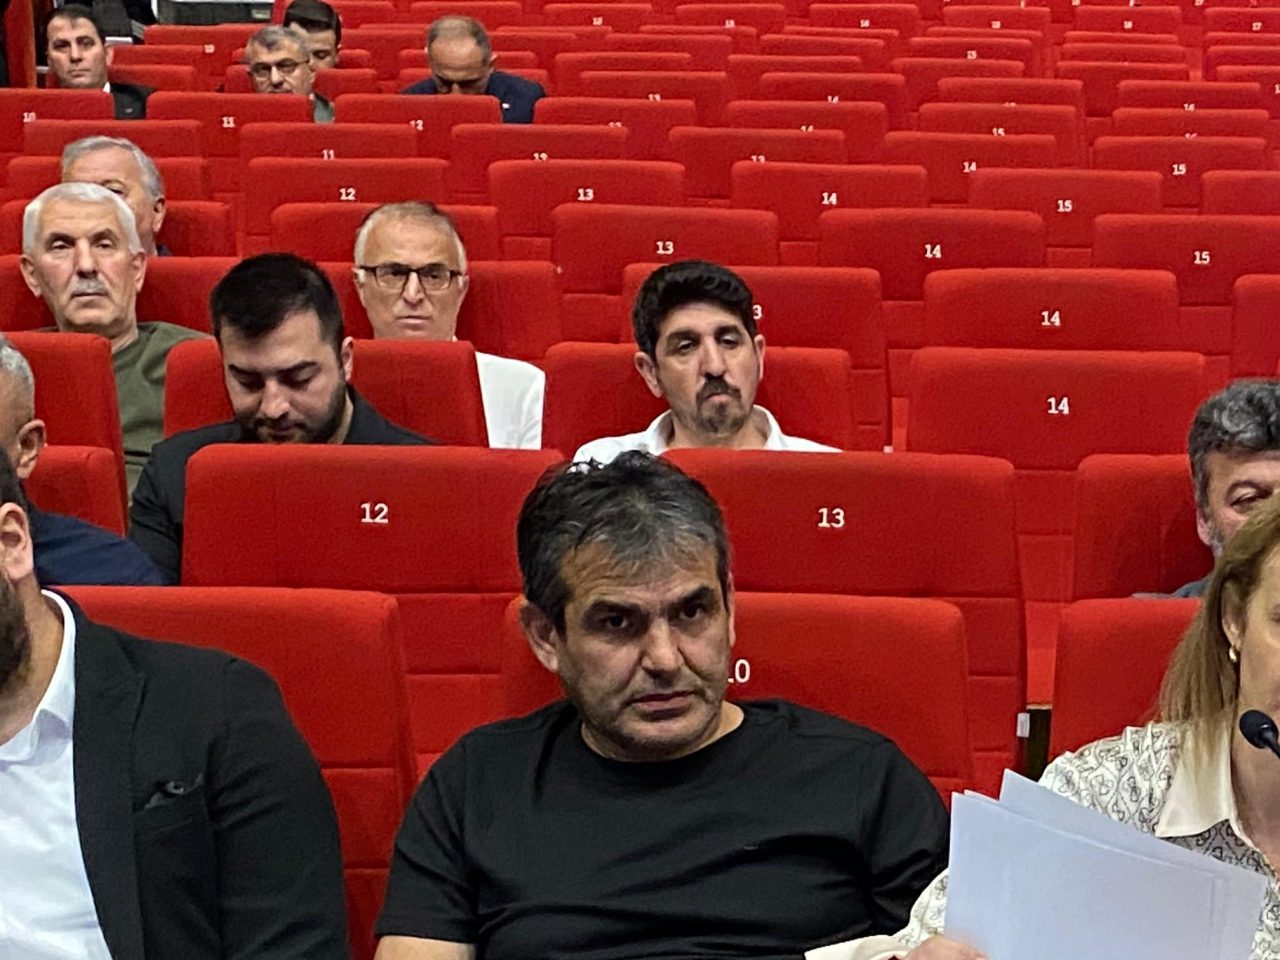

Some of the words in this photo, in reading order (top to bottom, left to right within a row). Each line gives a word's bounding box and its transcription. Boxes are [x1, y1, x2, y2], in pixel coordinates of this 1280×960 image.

[222, 116, 236, 128] 11
[322, 149, 335, 161] 11
[963, 161, 977, 173] 14
[1172, 163, 1187, 176] 15
[339, 187, 356, 201] 12
[577, 188, 594, 201] 13
[821, 191, 838, 206] 14
[1057, 199, 1073, 213] 15
[656, 240, 674, 255] 13
[924, 243, 942, 259] 14
[1193, 250, 1211, 265] 15
[752, 304, 763, 320] 3
[1041, 310, 1061, 327] 14
[1047, 396, 1070, 415] 14
[360, 502, 389, 524] 12
[817, 507, 845, 529] 13
[727, 658, 751, 683] 0
